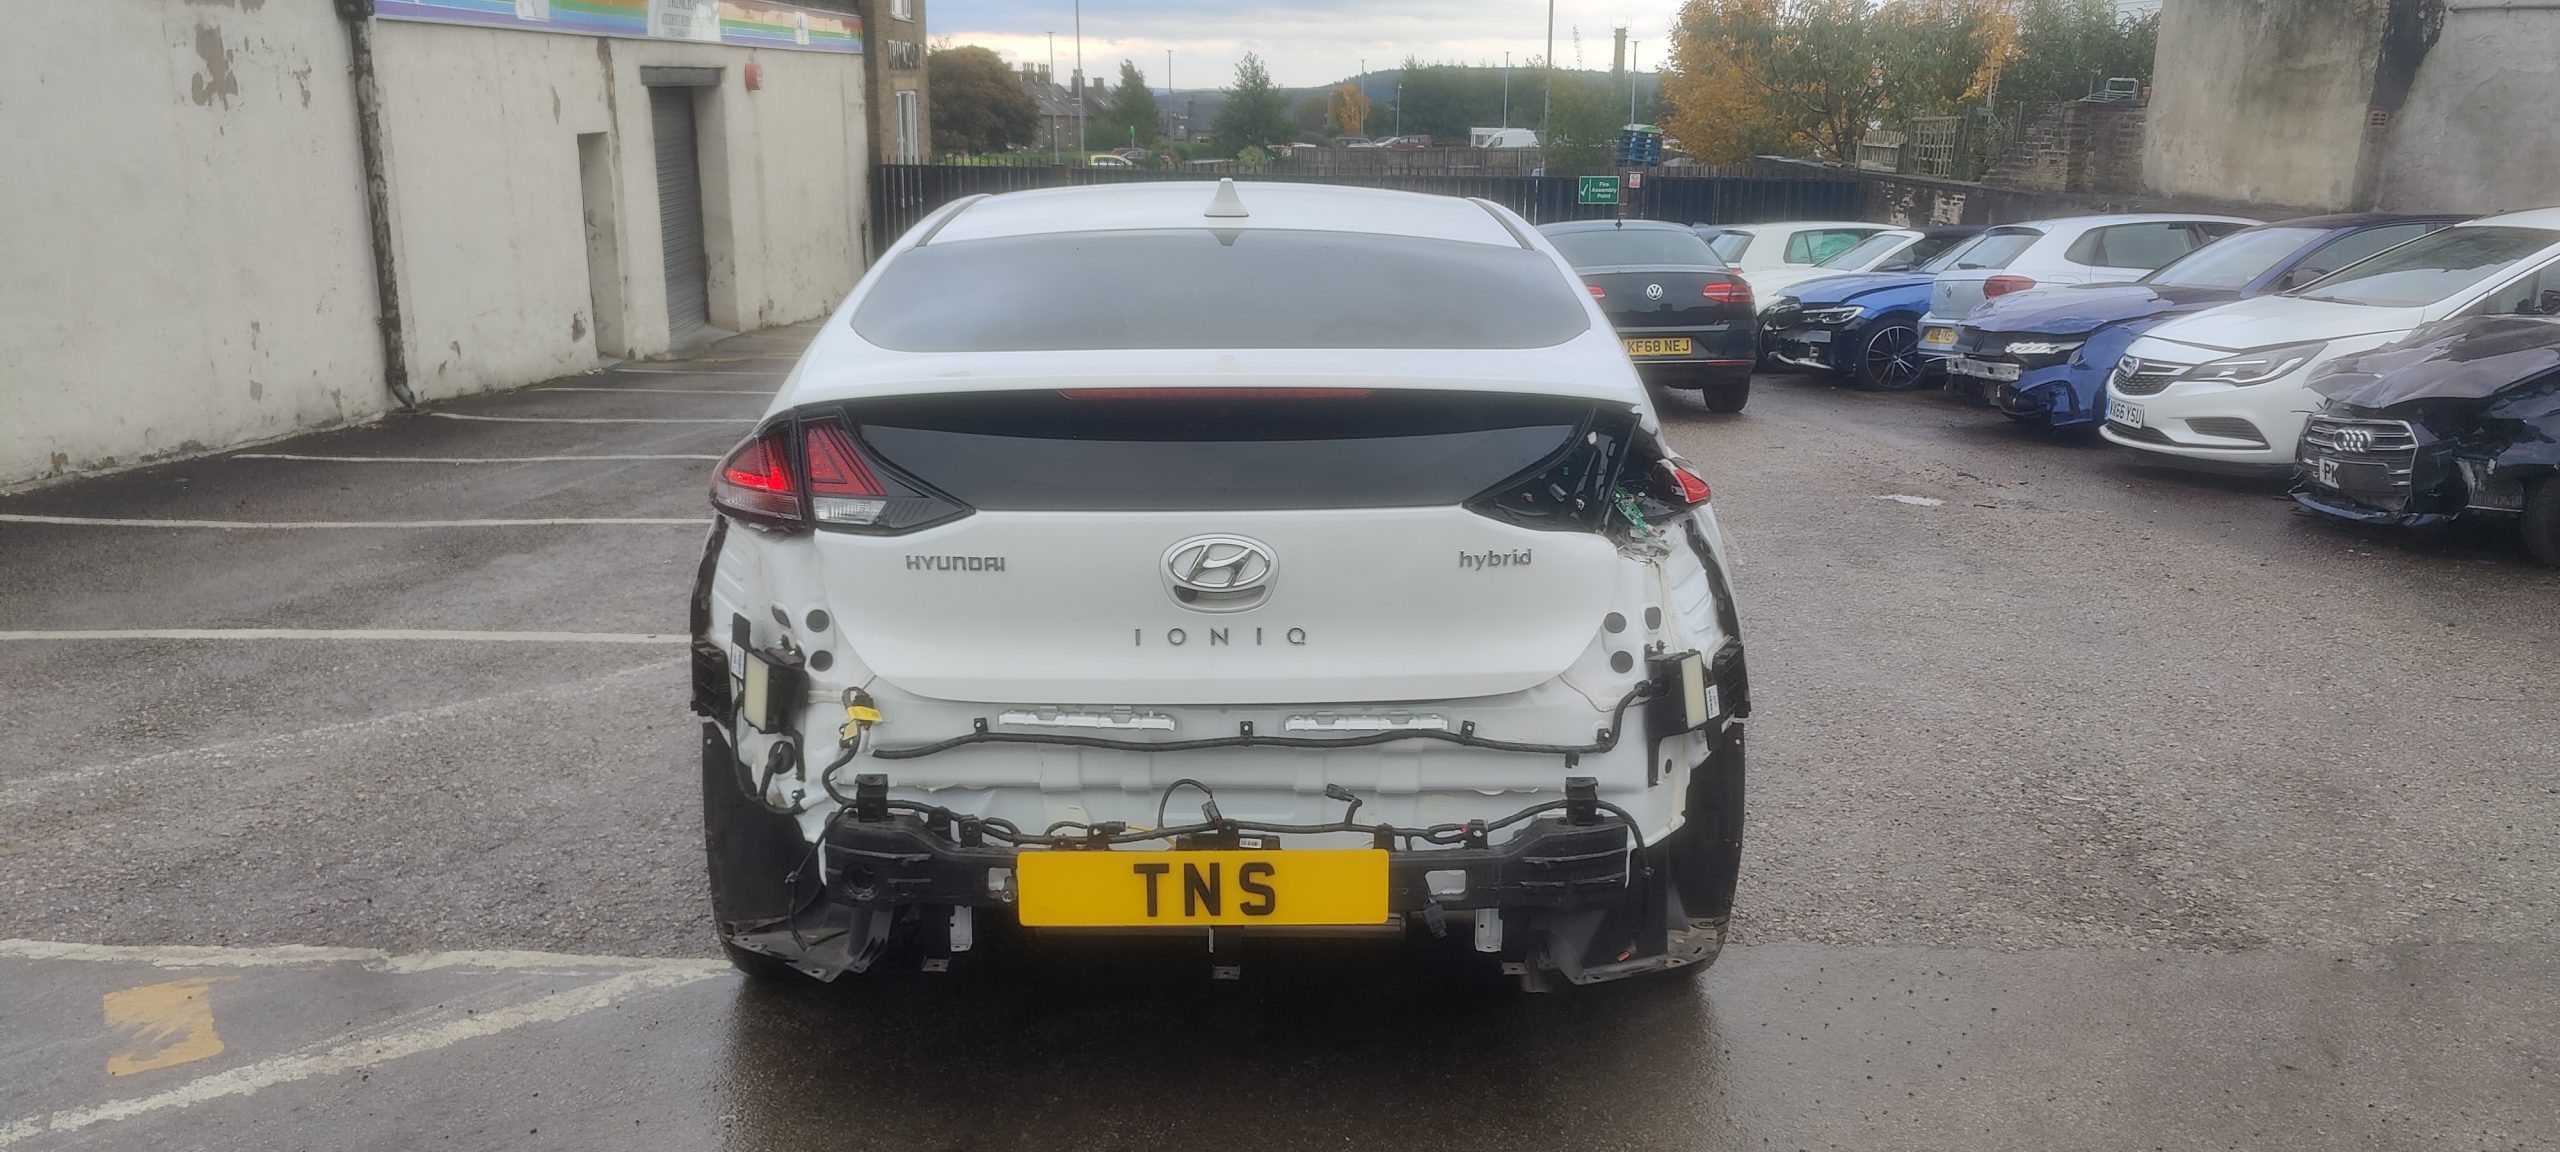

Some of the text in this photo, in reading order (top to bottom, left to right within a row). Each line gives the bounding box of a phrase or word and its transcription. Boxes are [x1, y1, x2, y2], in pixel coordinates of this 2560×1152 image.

[1627, 339, 1690, 353] KF68 NEJ
[2126, 405, 2143, 424] YSU
[905, 555, 1005, 572] HYUNDAI
[1459, 548, 1532, 572] hybrid
[1134, 626, 1307, 647] IONIQ
[1133, 861, 1276, 918] TNS
